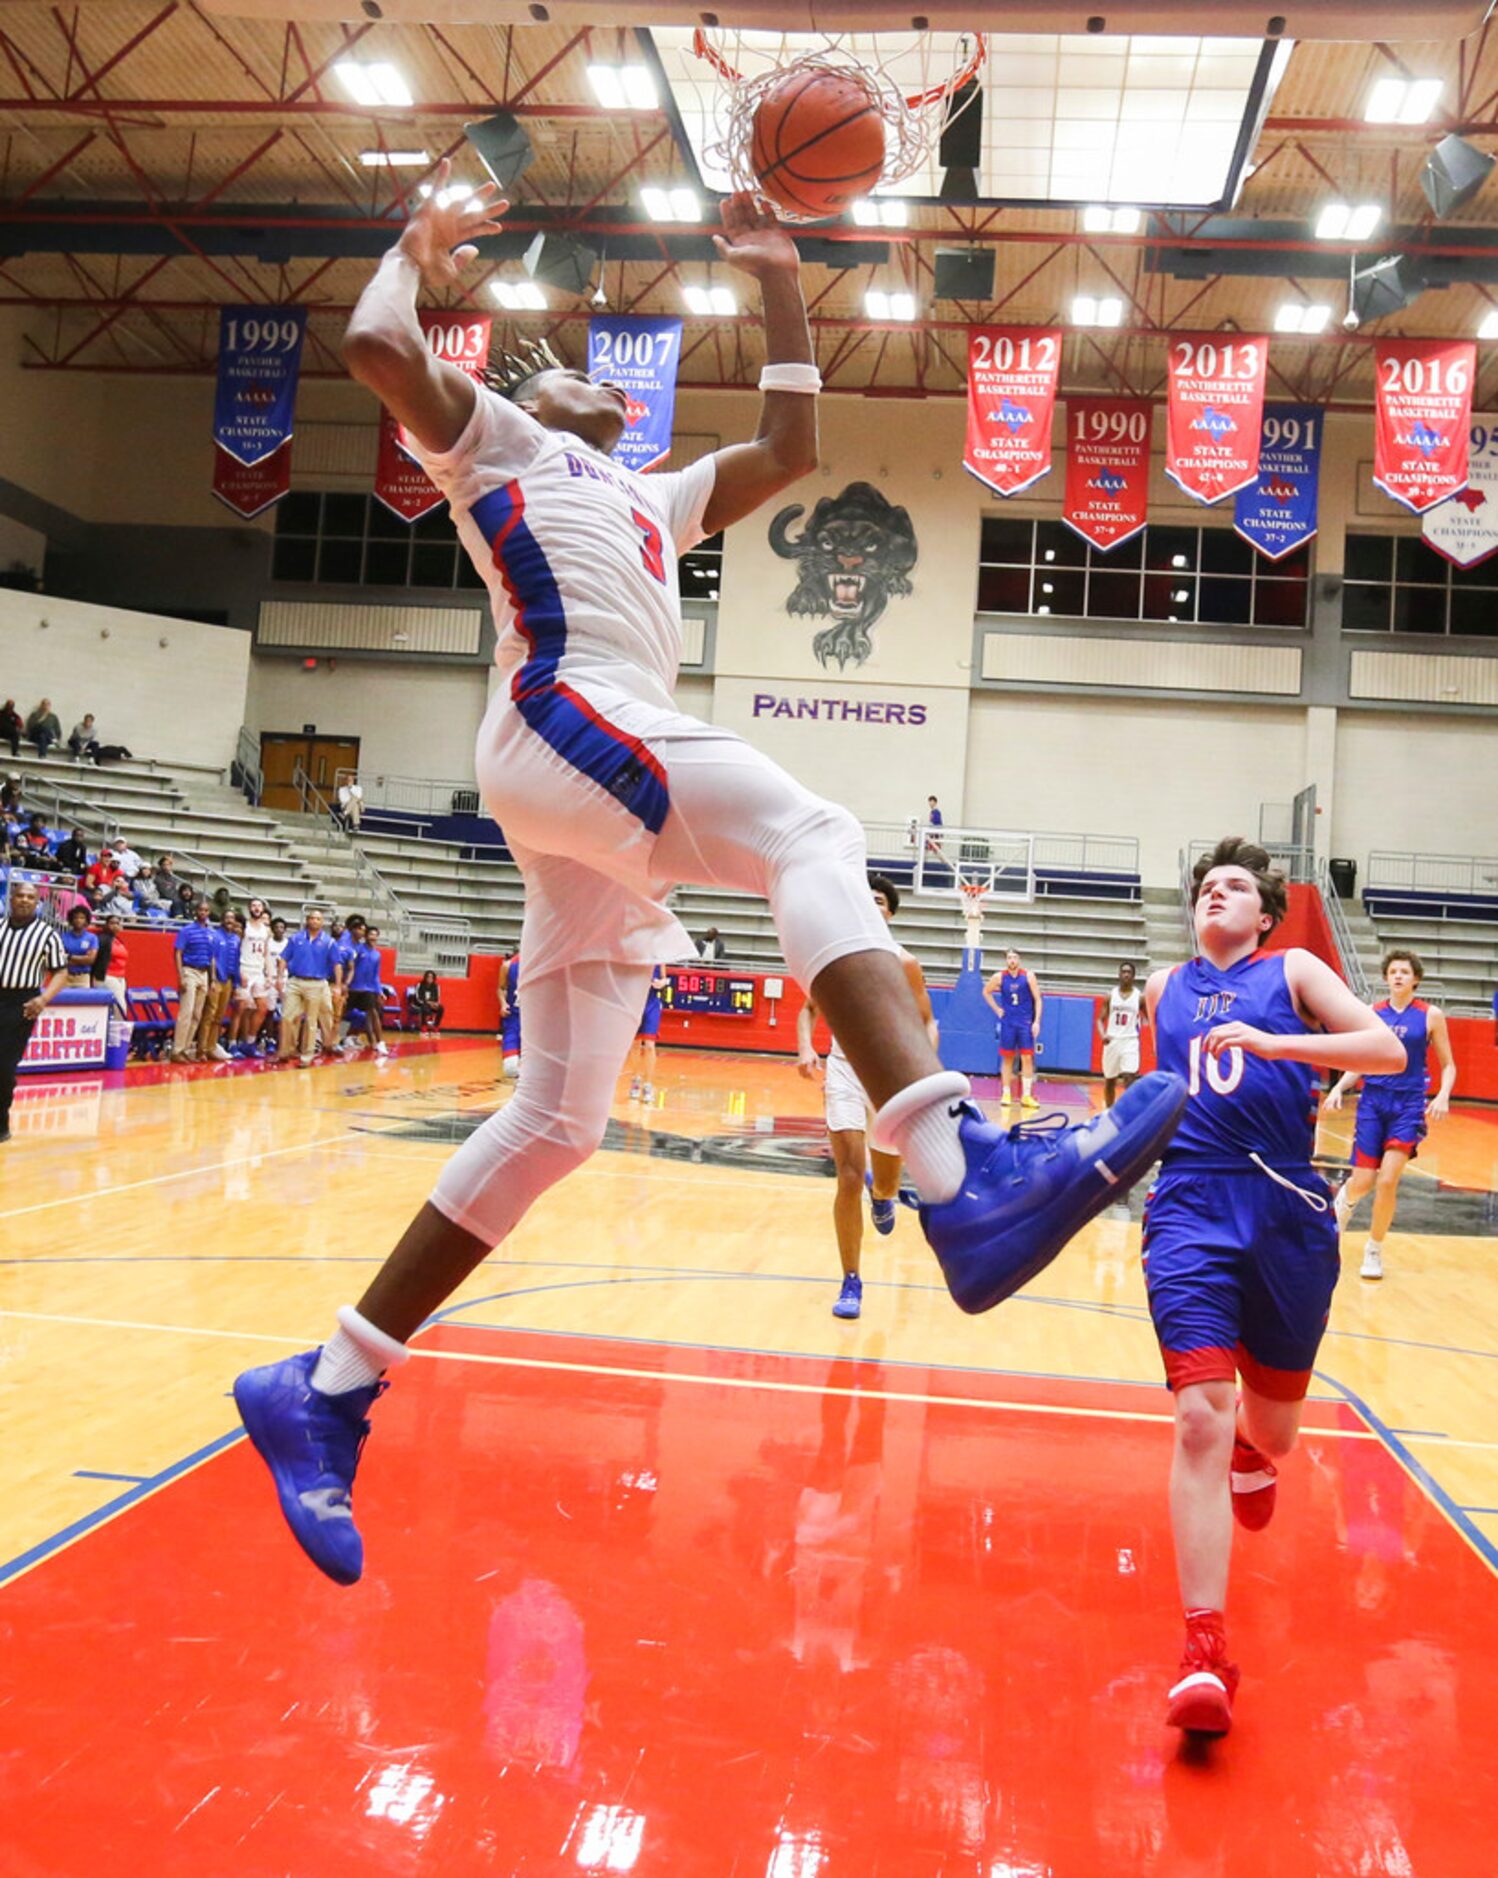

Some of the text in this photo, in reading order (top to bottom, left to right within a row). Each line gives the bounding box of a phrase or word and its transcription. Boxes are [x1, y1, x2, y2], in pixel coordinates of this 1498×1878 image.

[226, 319, 299, 352] 1999
[426, 323, 483, 358] 003
[593, 331, 676, 367] 2007
[972, 335, 1057, 372] 2012
[1174, 341, 1259, 379] 2013
[609, 366, 656, 378] PANTHER
[974, 371, 1052, 385] PANTHERETTE
[1382, 357, 1468, 395] 2016
[977, 384, 1048, 398] BASKETBALL
[1176, 379, 1255, 393] PANTHERETTE
[1179, 391, 1252, 406] BASKETBALL
[1385, 394, 1462, 408] PANTHERETTE
[625, 405, 652, 418] AAA
[1388, 405, 1458, 420] BASKETBALL
[235, 415, 268, 425] STATE
[219, 426, 284, 438] CHAMPIONS
[1074, 410, 1147, 444] 1990
[622, 432, 645, 442] ATE
[1262, 417, 1316, 451] 991
[990, 437, 1030, 449] STATE
[972, 448, 1044, 461] CHAMPIONS
[1074, 444, 1141, 456] PANTHERETTE
[1193, 445, 1234, 457] STATE
[1076, 455, 1139, 467] BASKETBALL
[1175, 457, 1249, 471] CHAMPIONS
[1259, 452, 1304, 463] PANTHER
[1257, 463, 1310, 474] ASKETBALL
[1401, 461, 1441, 473] STATE
[1384, 473, 1457, 486] CHAMPIONS
[1088, 501, 1122, 511] STATE
[1071, 511, 1137, 523] CHAMPIONS
[1259, 507, 1293, 519] STATE
[1242, 518, 1307, 531] CHAMPIONS
[751, 693, 928, 726] PANTHERS
[1187, 1033, 1245, 1097] 10
